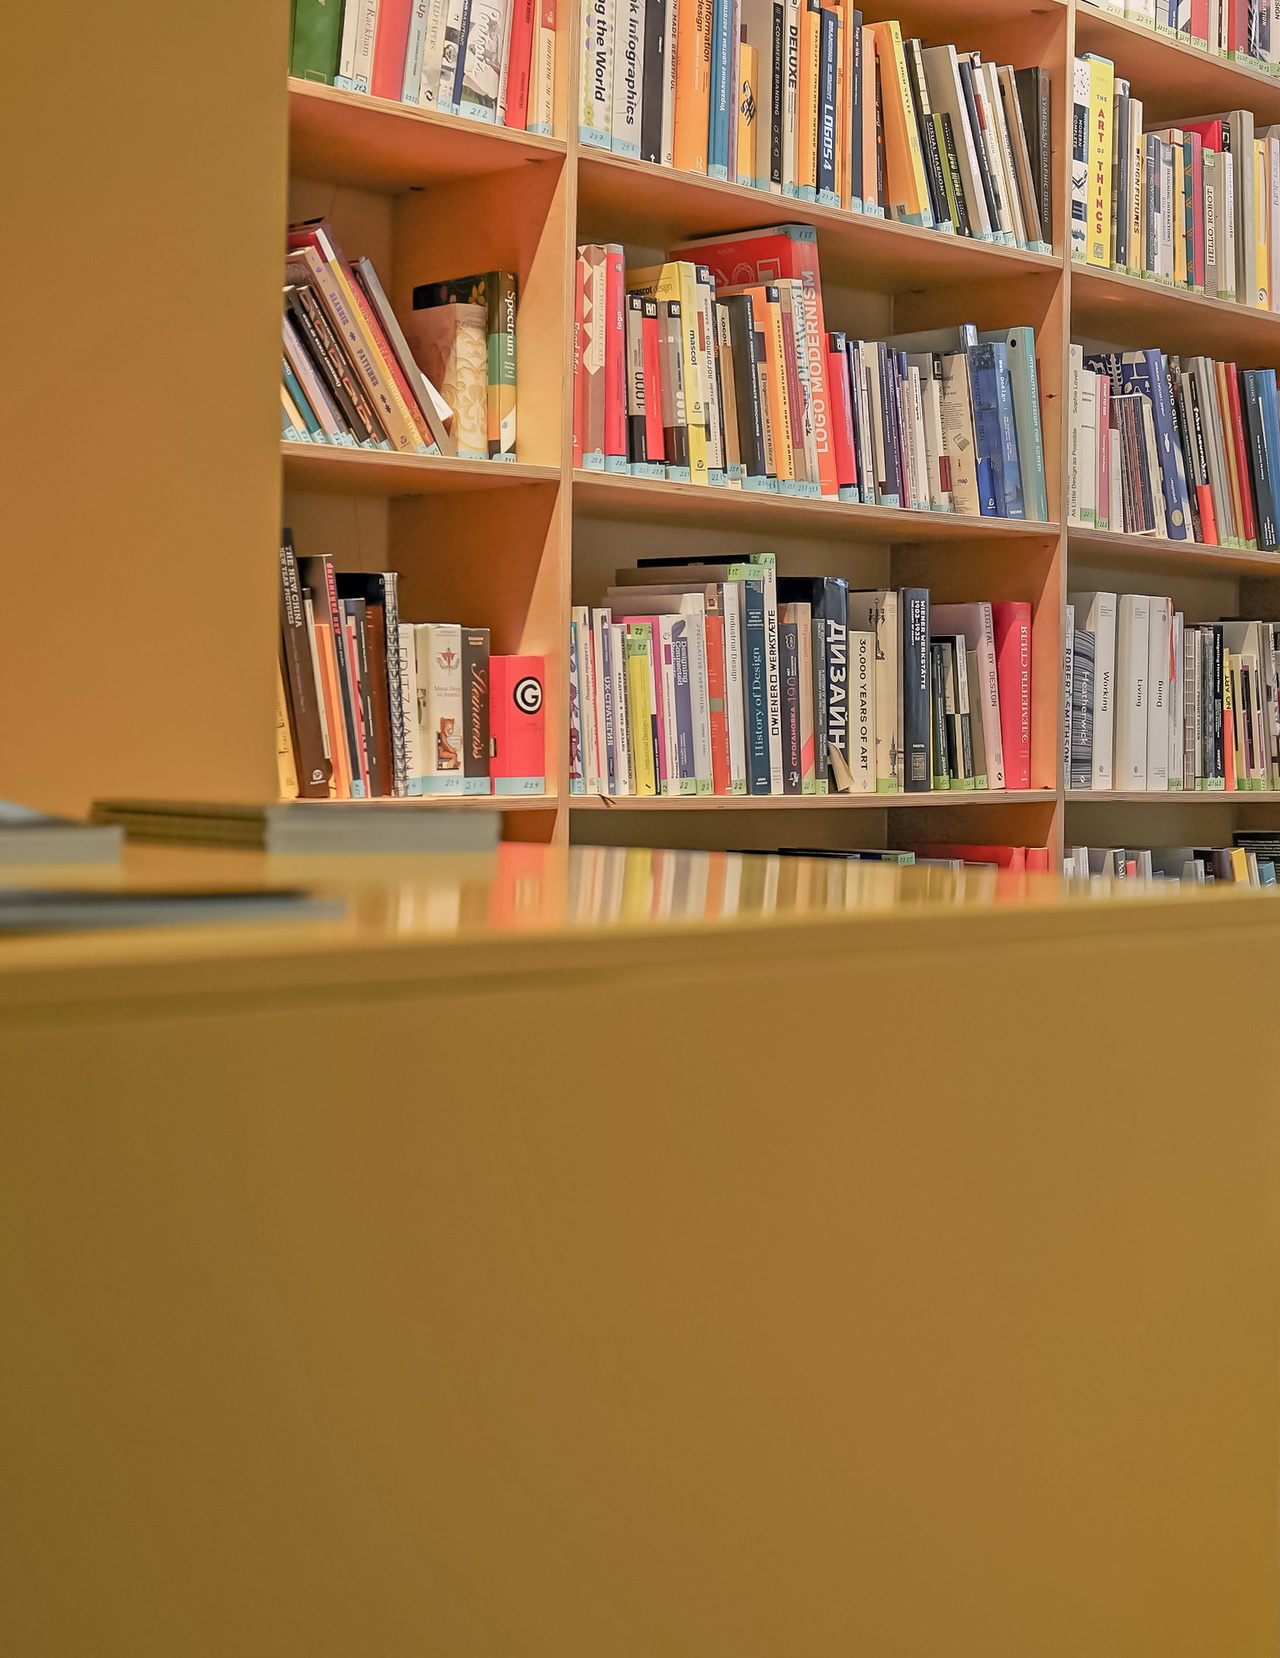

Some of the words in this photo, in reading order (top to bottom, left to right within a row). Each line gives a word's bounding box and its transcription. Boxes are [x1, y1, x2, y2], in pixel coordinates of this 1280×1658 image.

[362, 8, 375, 56] Rackham
[596, 19, 608, 46] the
[695, 0, 705, 32] design
[704, 0, 713, 62] Information
[626, 18, 639, 125] Infographics
[788, 25, 798, 89] DELUXE
[595, 51, 607, 102] World
[719, 66, 727, 111] Управление
[1096, 94, 1108, 102] THE
[928, 121, 939, 151] VISUAL
[933, 155, 946, 198] HARMONY
[1272, 151, 1280, 178] Finn
[1096, 161, 1104, 234] THINGS
[1228, 190, 1234, 199] of
[1272, 180, 1280, 207] Juhl
[505, 290, 516, 356] Spectrum
[599, 313, 604, 321] AT
[802, 271, 825, 393] MODERNISM
[689, 330, 698, 366] mascot
[762, 381, 770, 417] logolounge
[973, 370, 982, 407] TRENDS
[1166, 374, 1176, 406] DAVID
[1171, 409, 1179, 432] GILL
[815, 398, 829, 453] LOGO
[977, 424, 985, 442] GUI
[1193, 406, 1201, 431] fabio
[1071, 508, 1076, 517] As
[279, 547, 287, 564] NEW
[285, 545, 293, 566] THE
[281, 566, 290, 587] YEAR
[287, 568, 299, 593] NEW
[283, 588, 295, 625] PICTURES
[290, 594, 303, 629] CHINA
[729, 613, 737, 652] Industrial
[983, 606, 992, 647] DIGITAL
[681, 640, 689, 683] Designing
[859, 639, 867, 680] 30,000
[987, 653, 994, 664] BY
[1020, 626, 1028, 667] СТИЛЯ
[730, 653, 738, 682] Design
[752, 647, 762, 691] Design
[826, 619, 848, 751] ДИЗАЙН
[753, 695, 763, 706] of
[771, 684, 779, 727] WIENER
[787, 676, 797, 703] 190
[859, 683, 867, 723] YEARS
[989, 671, 997, 708] DESIGN
[1020, 671, 1028, 743] ЭЛЕМЕНТЫ
[1080, 671, 1089, 745] Heatherwick
[1101, 671, 1110, 712] Working
[1156, 680, 1164, 708] Doing
[604, 676, 613, 746] UX-СТРАТЕГИЯ
[754, 709, 764, 757] History
[860, 726, 867, 743] OF
[860, 746, 868, 771] ART
